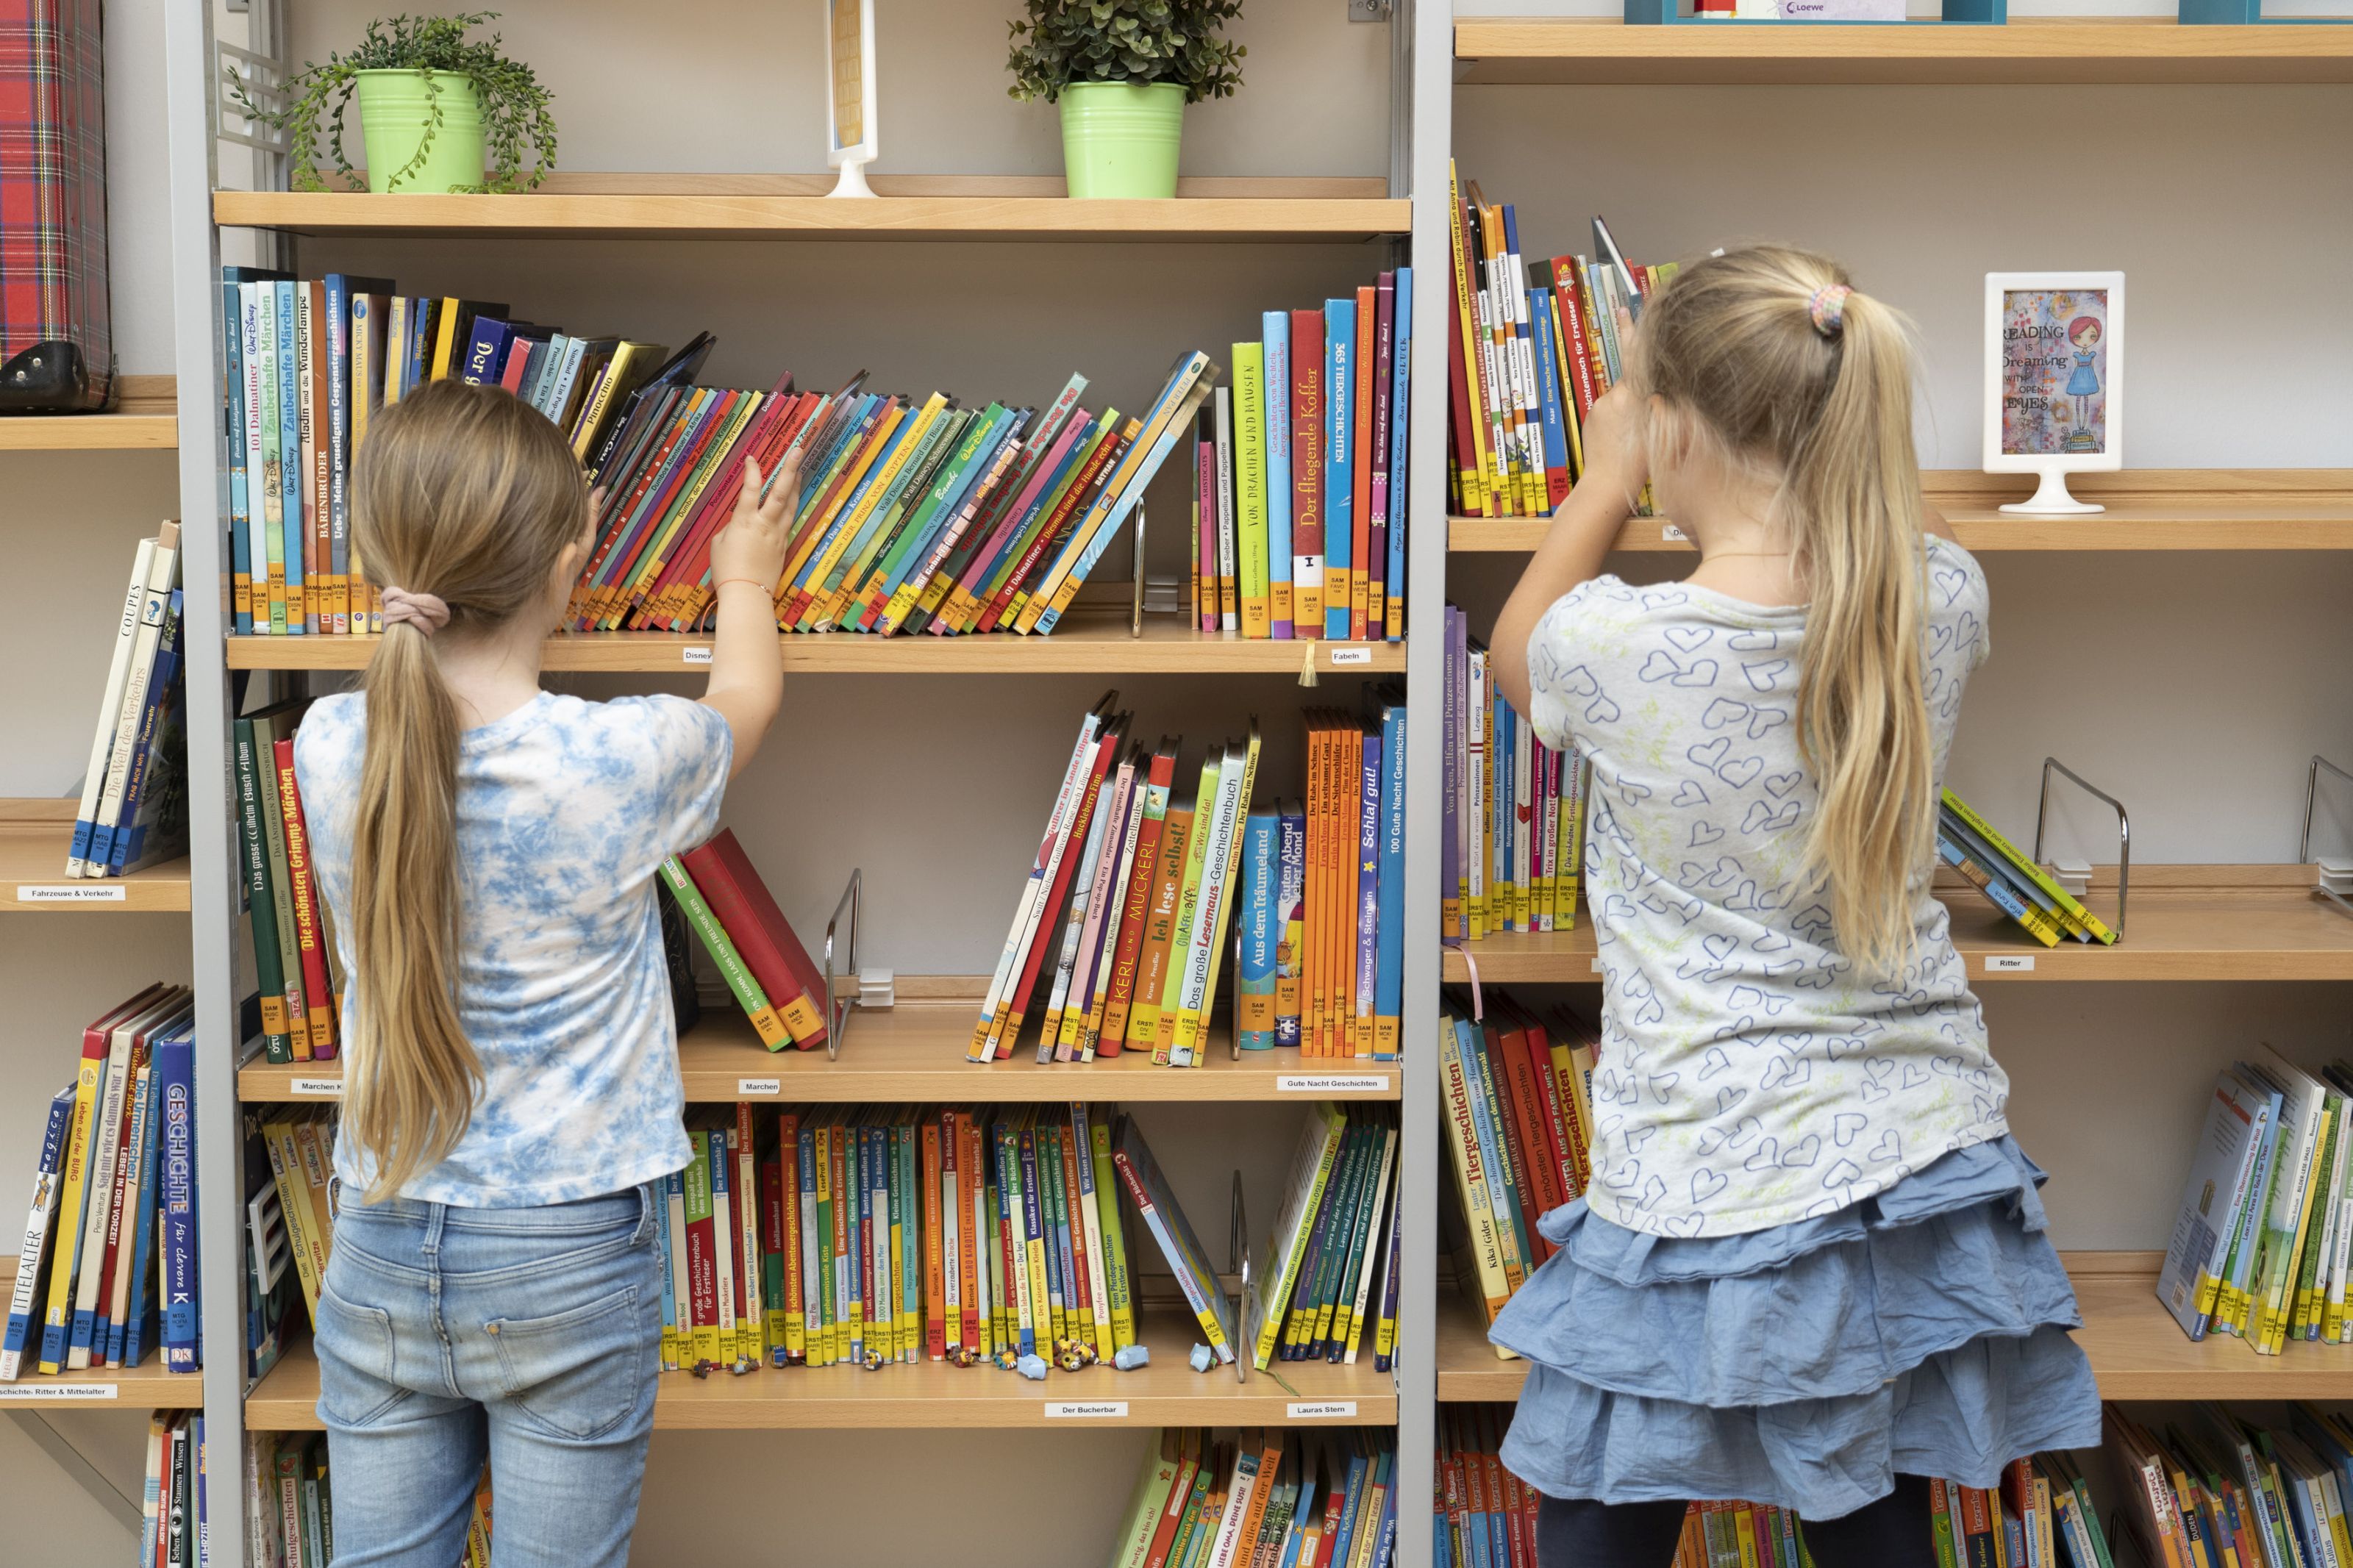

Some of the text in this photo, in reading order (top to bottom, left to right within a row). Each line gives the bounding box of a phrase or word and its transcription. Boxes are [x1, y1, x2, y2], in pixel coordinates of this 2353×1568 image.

[299, 296, 309, 372] Wunderlampe
[1568, 298, 1580, 339] Erstleser
[260, 296, 275, 434] Zauberhafte Märchen
[281, 294, 294, 432] Zauberhafte Märchen
[472, 341, 493, 373] Der
[546, 347, 560, 377] Pinocchio
[2004, 374, 2030, 382] WITH
[249, 365, 260, 451] 101 Dalmatiner
[329, 290, 345, 539] Uebe Meine gruseligsten Gespenstergeschichten
[588, 377, 613, 425] Pinocchio
[1335, 343, 1346, 462] 365 TIERGESCHICHTEN
[2007, 398, 2049, 415] EYES
[2019, 385, 2044, 394] OPEN
[301, 408, 310, 443] Aladin
[688, 414, 724, 465] Der Zauberlehrling
[1031, 387, 1078, 450] Die Streiche
[1245, 417, 1257, 443] UND
[700, 412, 748, 484] verschwundene Zirkusstar
[903, 418, 963, 500] Walt Disneys Schneewittchen
[1298, 368, 1321, 526] Der fliegende Koffer
[317, 451, 329, 538] BÄRENBRÜDER
[710, 472, 734, 507] Pocahontas
[826, 499, 844, 520] Tarzan
[935, 471, 959, 500] Bambi
[997, 507, 1022, 540] Cinderella
[1010, 443, 1112, 585] Dalmatiner Diesmal Hunde echt
[1247, 506, 1259, 528] VON
[121, 584, 142, 637] COUPES
[105, 667, 146, 800] Die Welt des Verkehrs
[143, 704, 156, 742] Feuerwehr
[280, 767, 297, 820] Märchen
[1048, 728, 1091, 836] Gulliver im Lande Liliput
[1074, 773, 1102, 839] Huckleberry Finn
[1363, 767, 1378, 848] Schlaf gut!
[1391, 719, 1405, 854] 100 Gute Nacht Geschichten
[289, 823, 304, 867] Grimms
[1125, 801, 1142, 854] Zottelhaube
[1534, 795, 1542, 856] Lieblingsgeschichten
[1546, 800, 1557, 875] Trix großer Not!
[32, 890, 72, 898] Fahrzeuge
[1129, 839, 1156, 921] MUCKERL
[1151, 823, 1186, 942] Ich lese selbst!
[1252, 828, 1268, 967] Aus dem Träumeland
[301, 928, 314, 951] Die
[1363, 891, 1373, 935] Steinlein
[1188, 986, 1202, 1009] Das
[1196, 949, 1207, 984] große
[1362, 947, 1373, 997] Schwager
[301, 1083, 335, 1091] Marchen
[1331, 1079, 1377, 1087] Geschichten
[1517, 1063, 1543, 1153] Tiergeschichten
[1542, 1063, 1560, 1117] FABELWELT
[77, 1102, 88, 1124] Leben
[127, 1079, 147, 1179] Die Urmenschen
[1076, 1123, 1085, 1155] zusammen
[1449, 1062, 1482, 1185] Tiergeschichten
[1479, 1051, 1513, 1186] Geschichten Fabelwald
[71, 1159, 80, 1182] BURG
[167, 1083, 189, 1289] GESCHICHTE für clevere
[819, 1161, 827, 1192] LeseProfi
[1122, 1164, 1143, 1192] Bücherbär
[2296, 1146, 2311, 1193] BILDER-LESE-SPASS
[107, 1147, 128, 1246] LEBEN IN DER VORZEIT
[282, 1182, 306, 1259] Schulgeschichten
[836, 1199, 844, 1236] Geschichte
[1030, 1207, 1038, 1236] Klassiker
[787, 1192, 798, 1276] Abenteuergeschichten
[1481, 1217, 1498, 1270] Kika/Gider
[692, 1232, 701, 1295] Geschichtenbuch
[1062, 1246, 1074, 1311] Piratengeschichten
[1107, 1234, 1120, 1293] Pferdegeschichten
[173, 1350, 190, 1360] DK
[1323, 1406, 1345, 1414] Stern
[171, 1442, 184, 1561] Sehen Staunen Wissen
[1240, 1455, 1277, 1567] und alles auf der Welt
[2187, 1514, 2199, 1541] DUDEN
